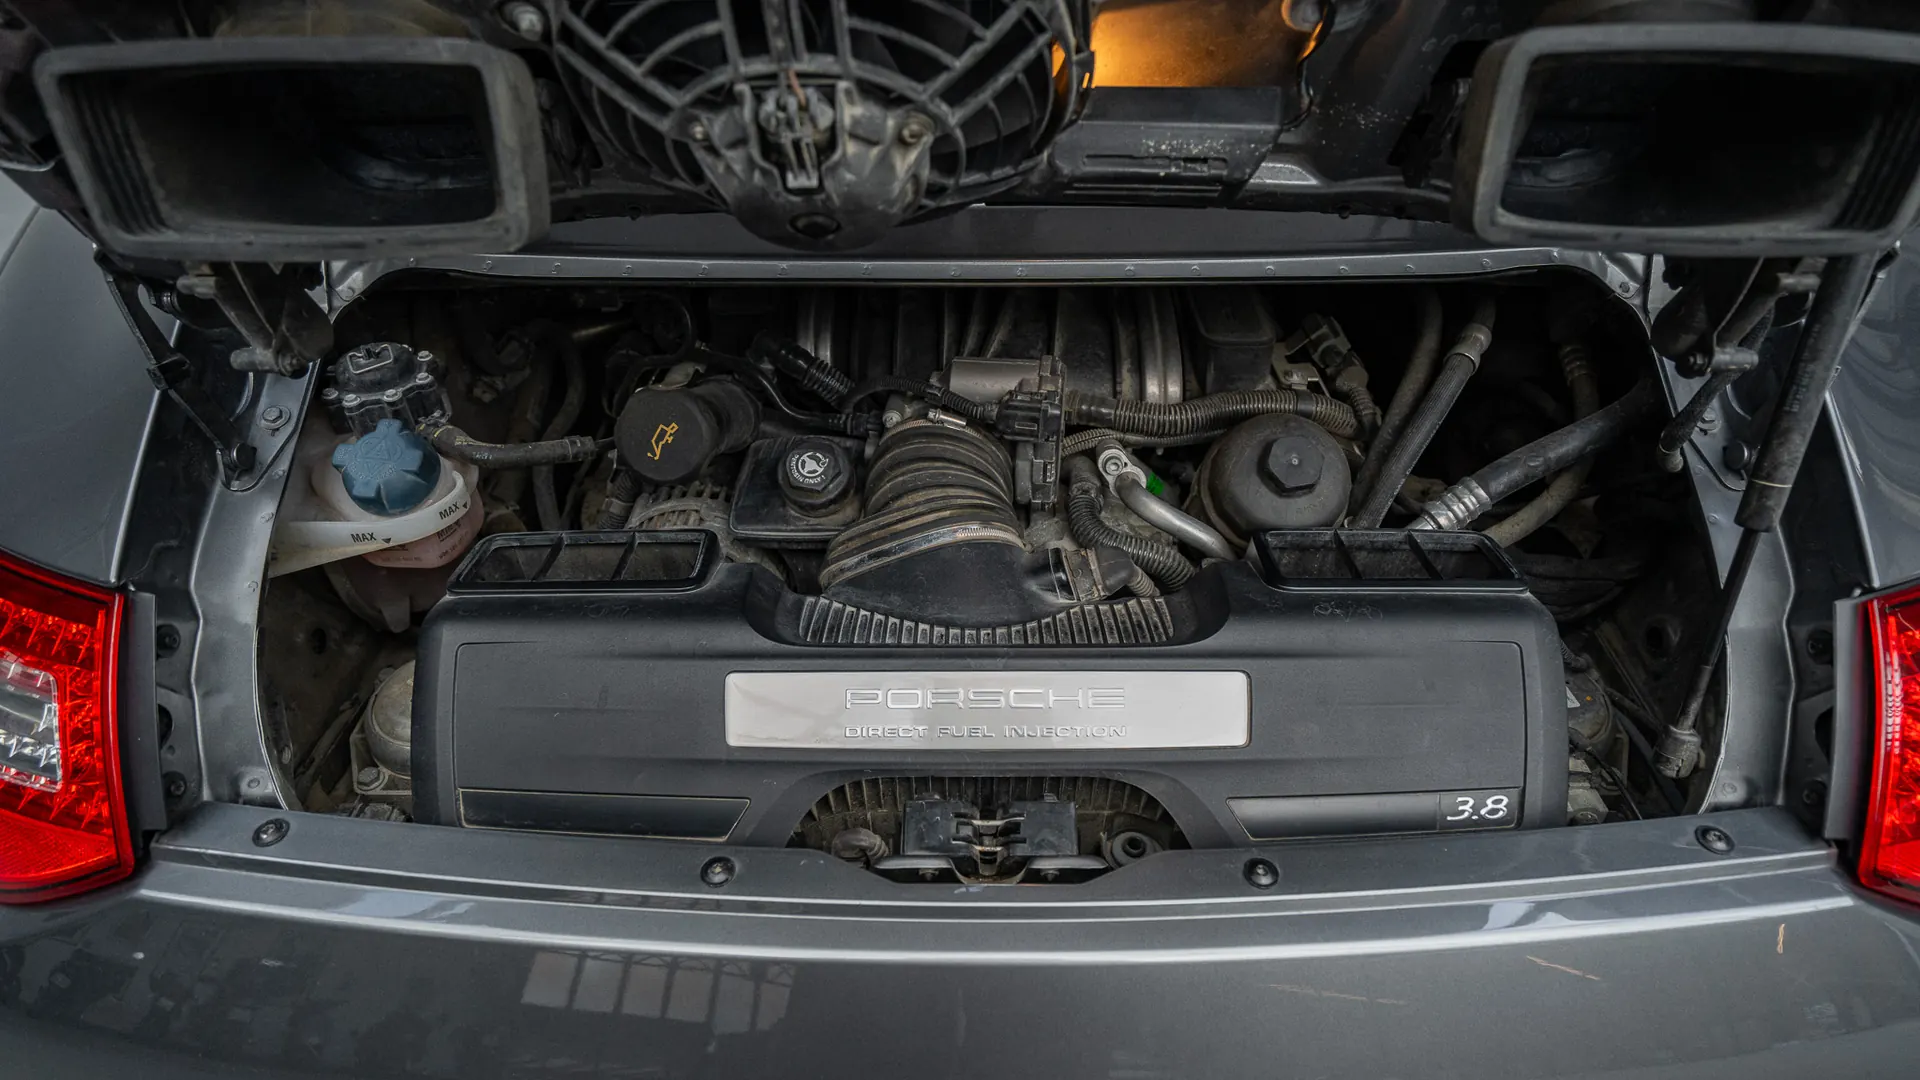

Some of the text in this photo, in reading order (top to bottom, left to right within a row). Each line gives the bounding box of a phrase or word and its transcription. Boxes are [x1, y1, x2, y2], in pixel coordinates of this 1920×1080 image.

[439, 502, 460, 520] MAX
[350, 532, 377, 543] MAX
[844, 687, 1126, 710] PORSCHE
[844, 725, 1127, 738] DIRECT FUEL INJECTION
[1446, 794, 1509, 821] 3.8
